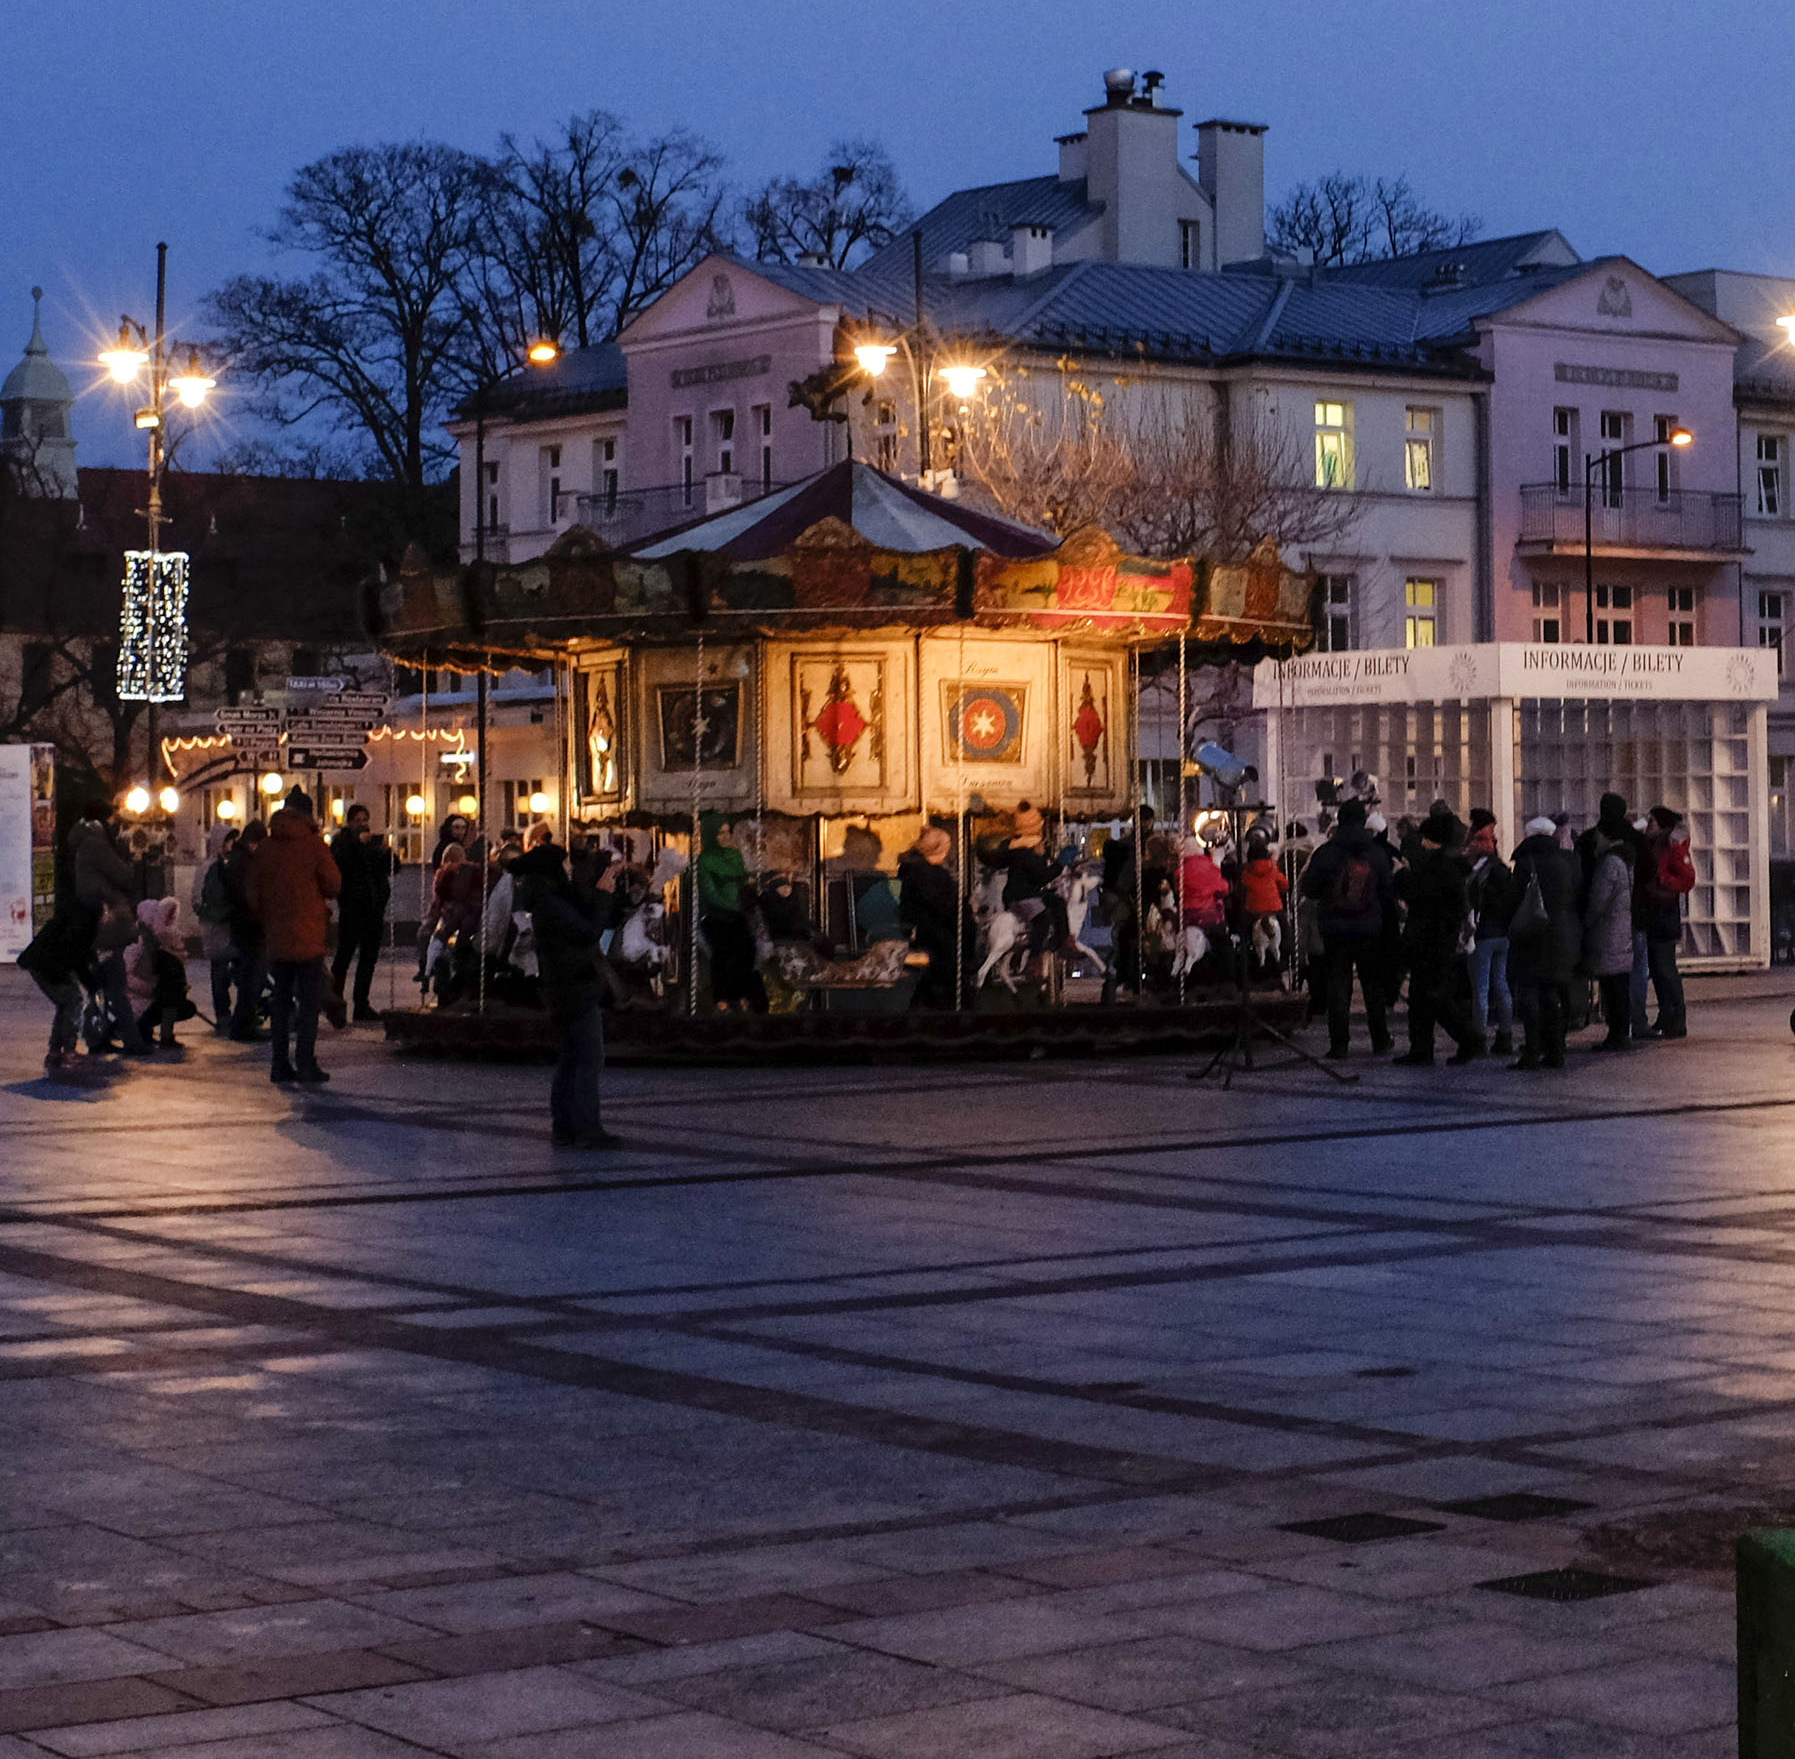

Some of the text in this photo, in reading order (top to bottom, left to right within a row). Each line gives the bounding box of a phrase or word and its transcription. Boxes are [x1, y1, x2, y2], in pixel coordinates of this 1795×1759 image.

[1273, 656, 1410, 681] INFORMACJE / BILETY
[1523, 651, 1684, 675] INFORMACJE / BILETY
[1566, 678, 1617, 690] INFORMATION
